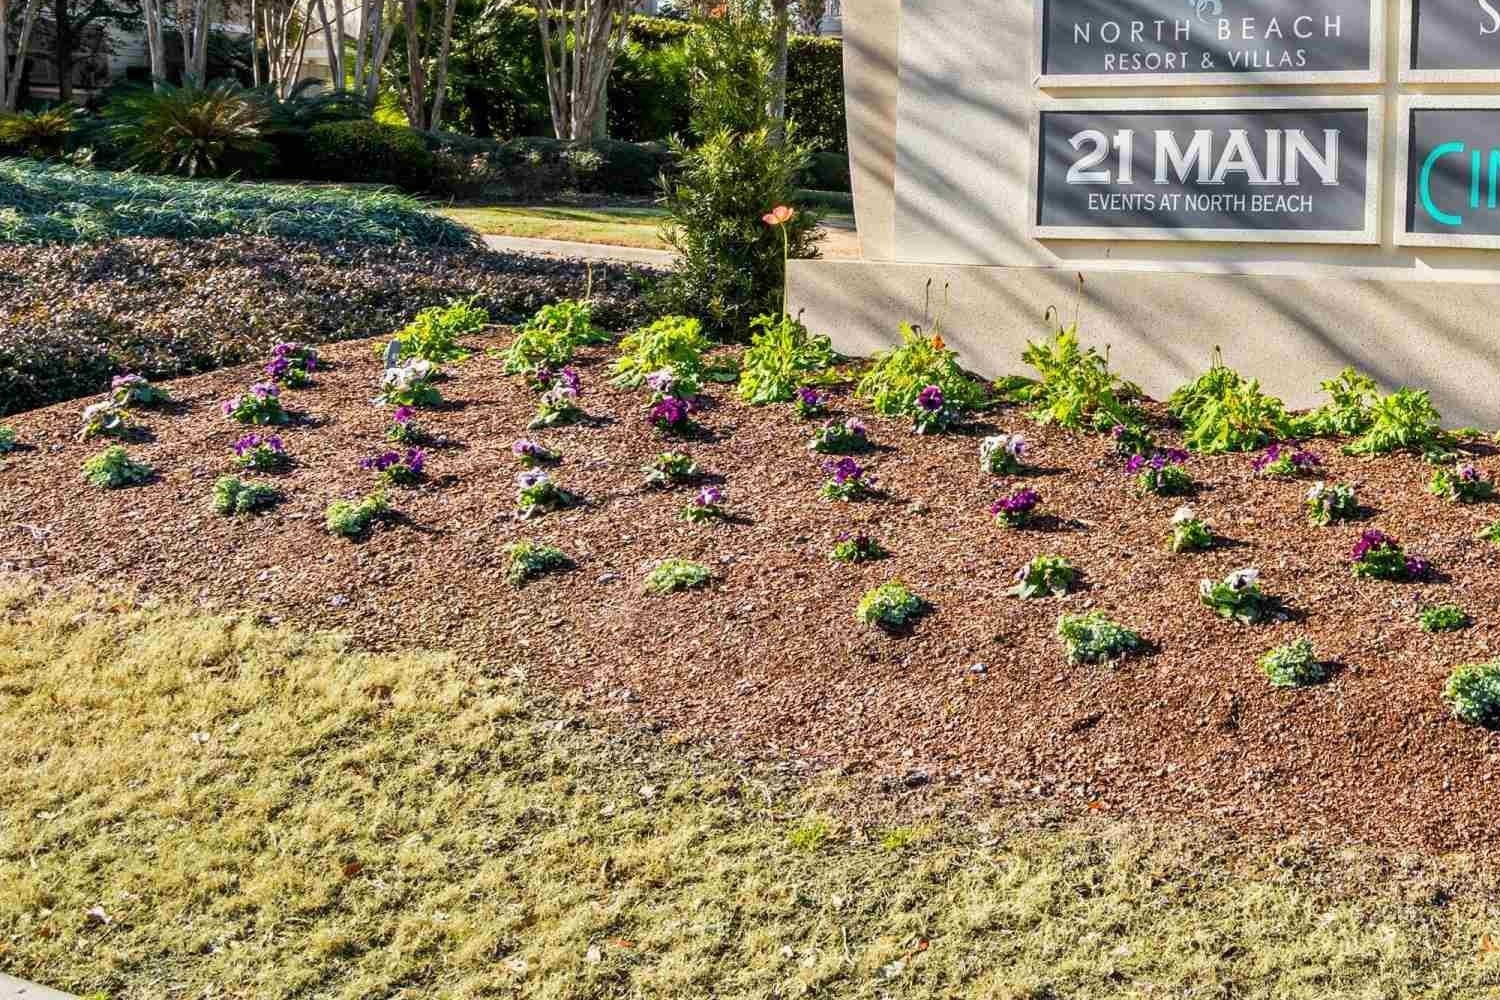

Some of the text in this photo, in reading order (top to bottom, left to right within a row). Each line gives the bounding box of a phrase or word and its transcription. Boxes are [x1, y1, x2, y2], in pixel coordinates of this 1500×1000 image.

[1073, 15, 1341, 44] NORTH BEACH
[1104, 48, 1306, 71] RESORT & VILLAS
[1065, 128, 1342, 186] 21 MAIN
[1088, 193, 1313, 213] EVENTS AT NORTH BEACH
